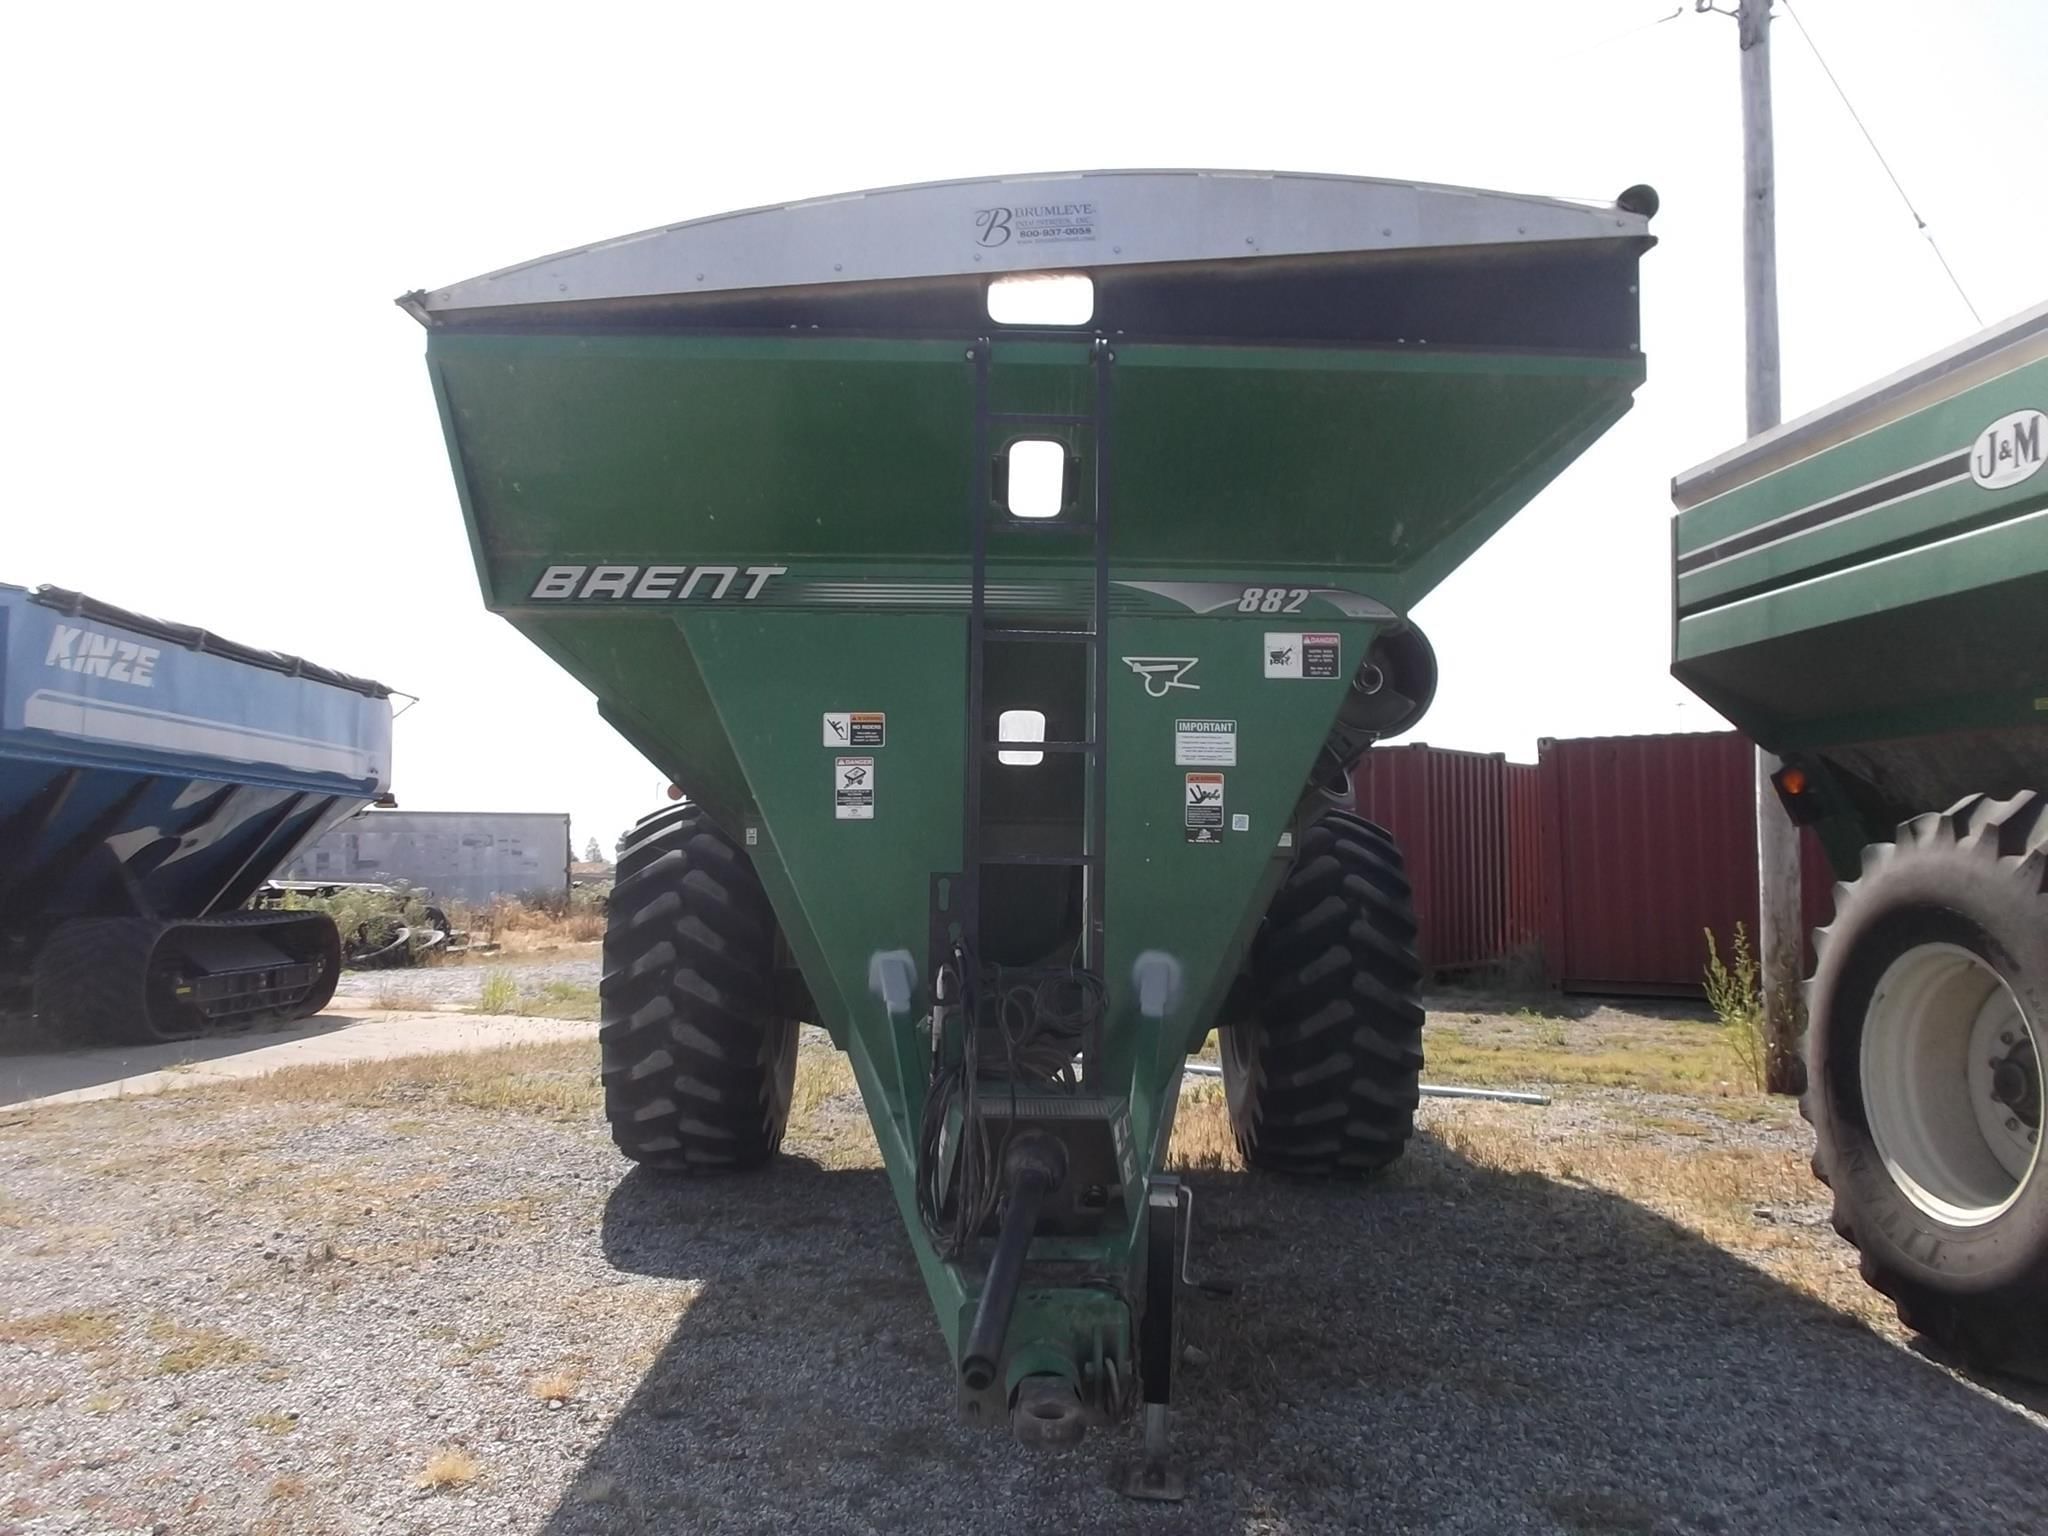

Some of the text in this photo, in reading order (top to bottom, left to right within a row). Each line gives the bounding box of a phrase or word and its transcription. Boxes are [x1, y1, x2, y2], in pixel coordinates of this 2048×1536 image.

[1015, 204, 1092, 217] BRUMLEVE
[1977, 414, 2041, 479] J&M
[531, 565, 788, 600] BRENT
[1237, 588, 1309, 613] 882
[45, 624, 160, 687] KINZE
[1179, 722, 1233, 732] IMPORTANT
